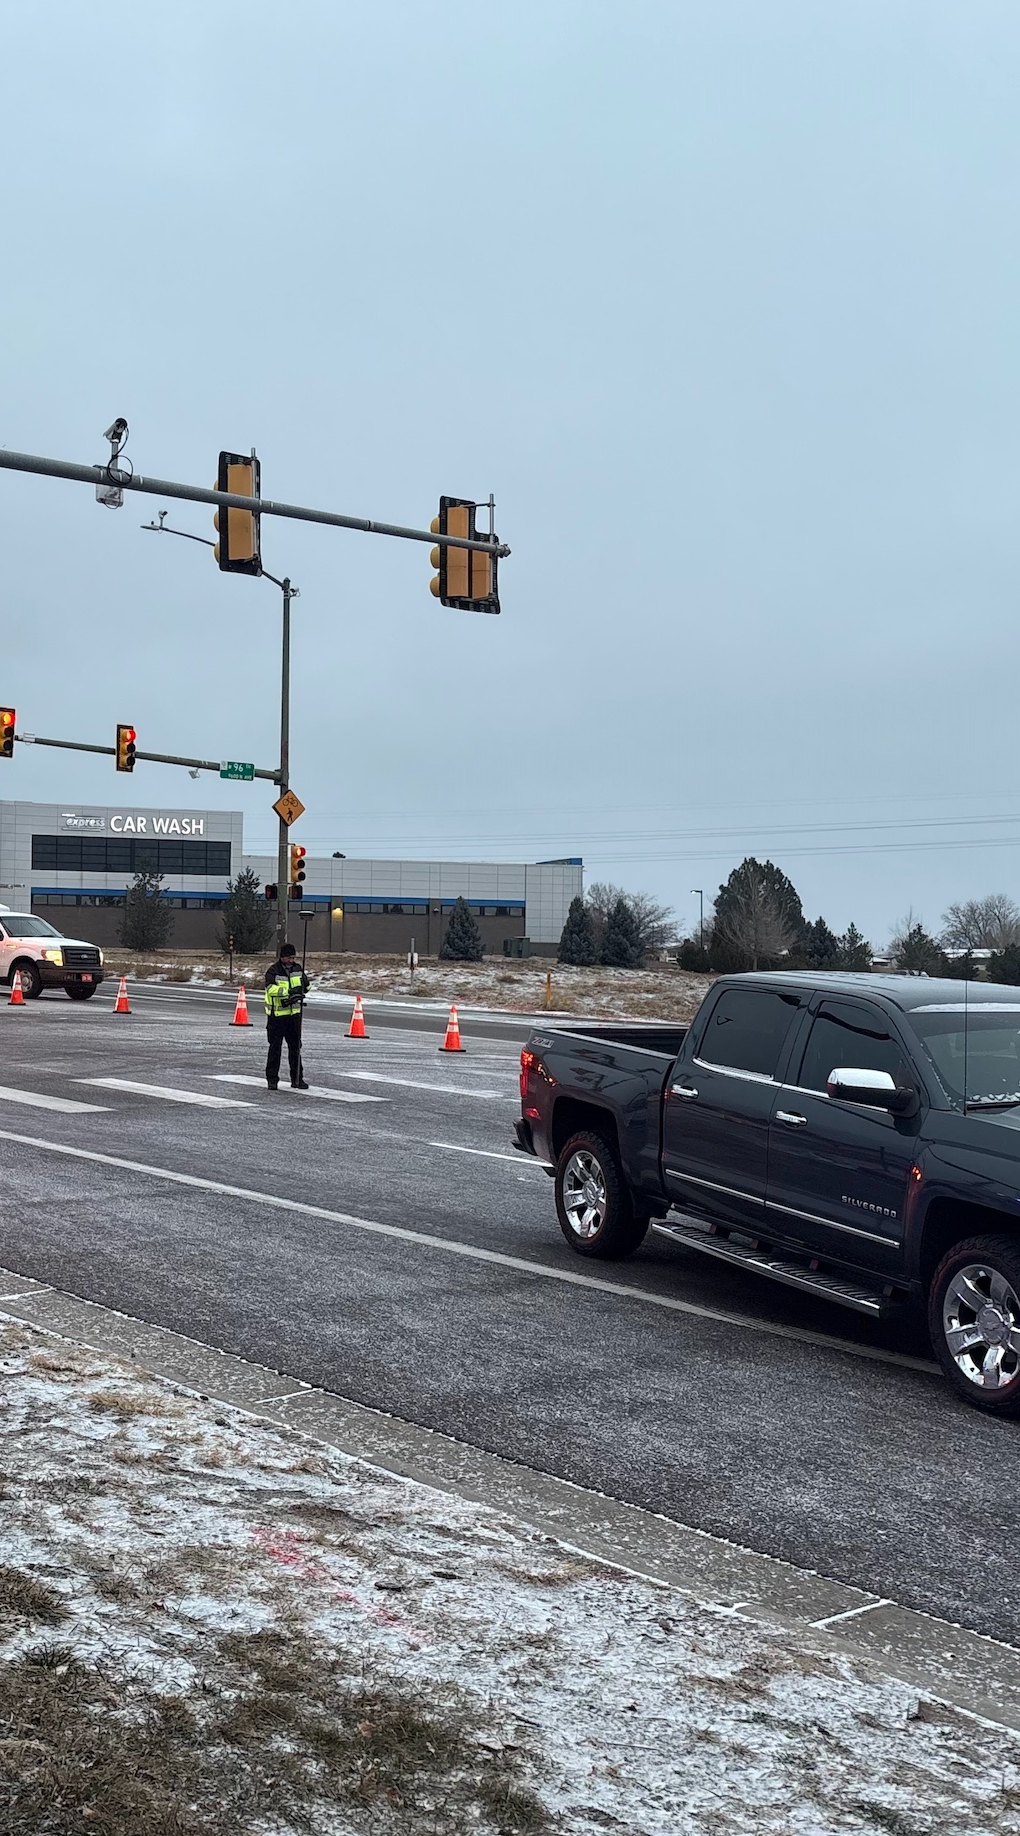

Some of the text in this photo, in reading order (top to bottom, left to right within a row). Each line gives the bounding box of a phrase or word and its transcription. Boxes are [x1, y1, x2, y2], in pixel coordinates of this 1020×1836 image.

[233, 763, 244, 772] 96
[66, 815, 204, 835] express CAR WASH
[841, 1195, 897, 1218] SILVERADO
